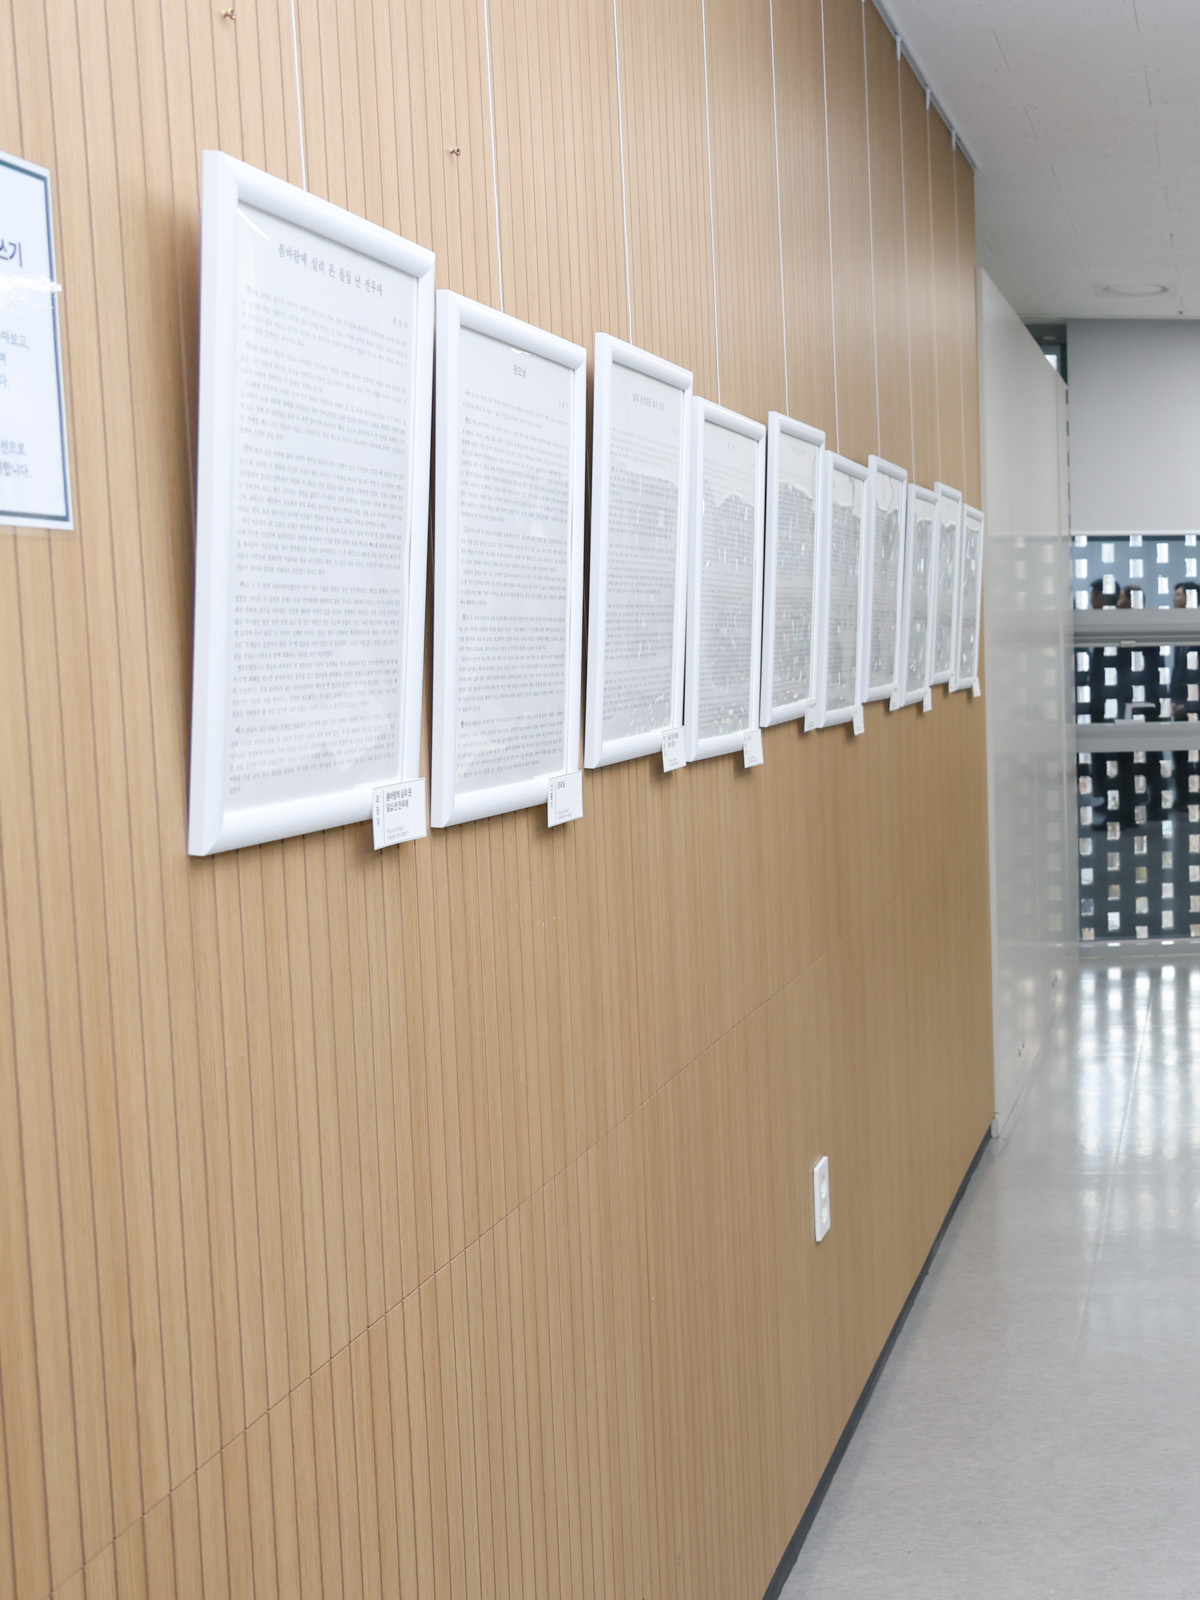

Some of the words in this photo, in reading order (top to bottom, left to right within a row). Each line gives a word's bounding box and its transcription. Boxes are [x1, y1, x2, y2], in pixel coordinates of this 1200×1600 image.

[278, 243, 307, 267] 봄바람에
[312, 257, 325, 274] 실려
[329, 263, 335, 278] 온
